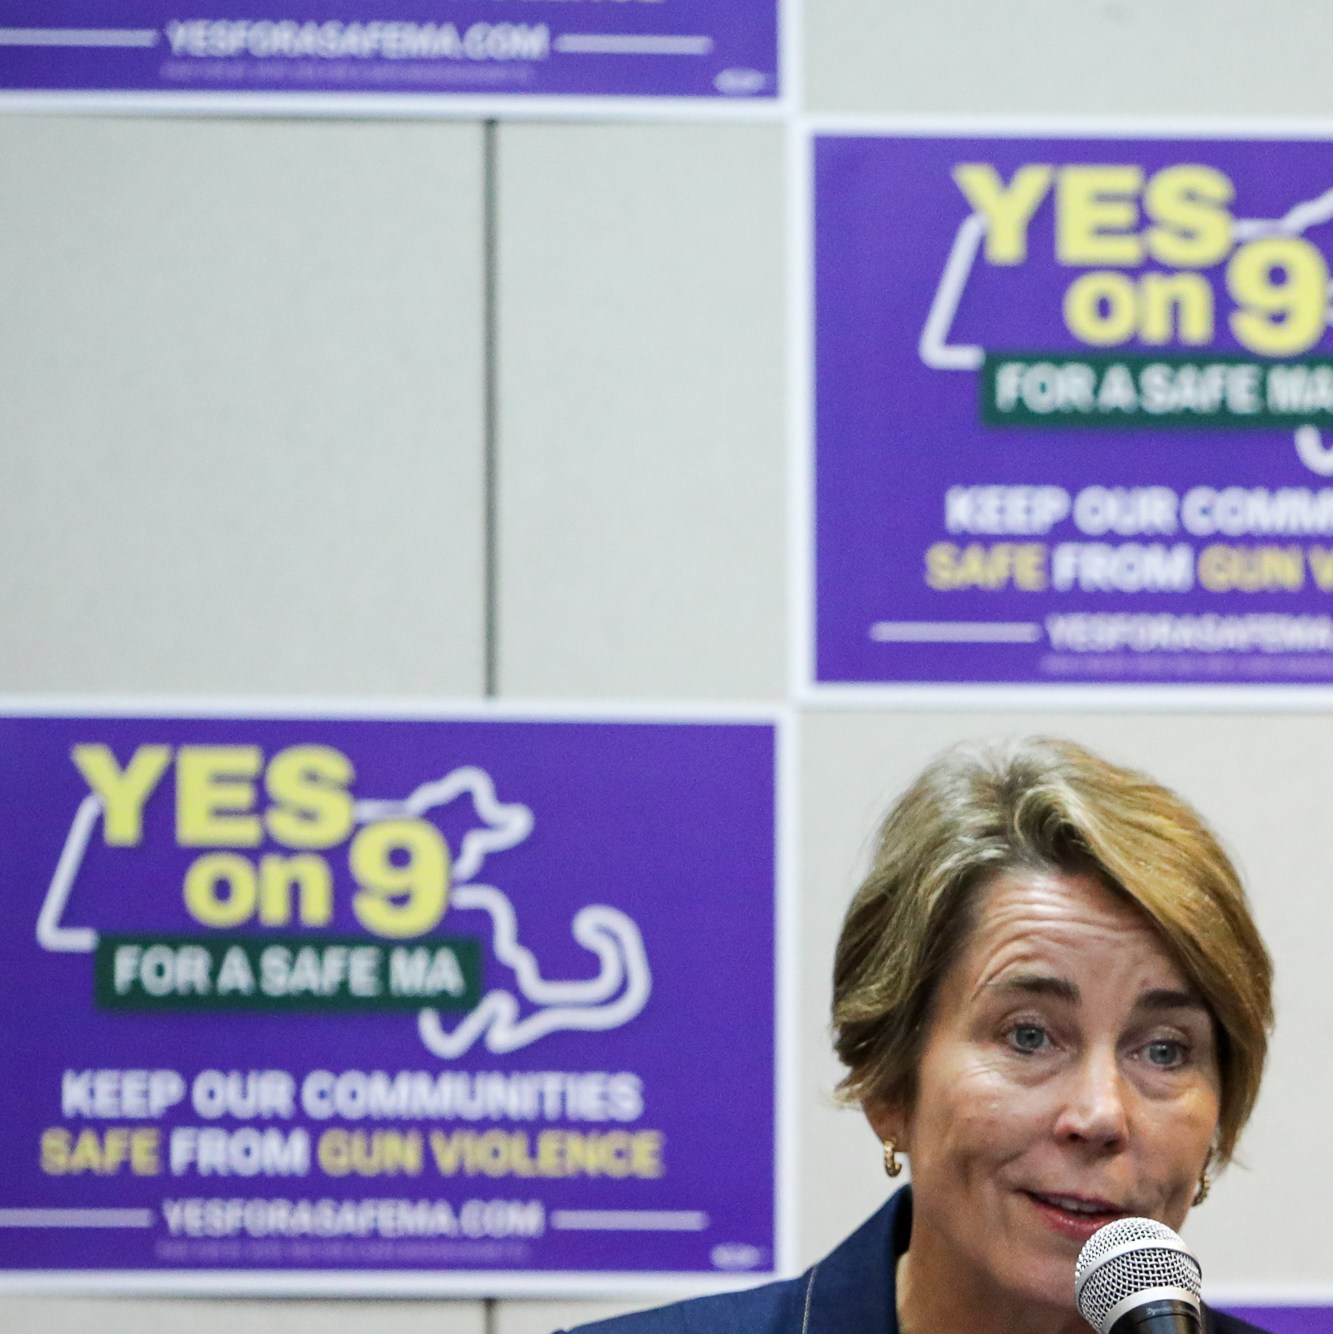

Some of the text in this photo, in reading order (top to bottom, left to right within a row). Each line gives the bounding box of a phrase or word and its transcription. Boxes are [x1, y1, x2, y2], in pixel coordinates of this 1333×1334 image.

[952, 163, 1234, 266] YES
[1063, 236, 1329, 356] on 9
[996, 363, 1096, 413] FOR
[1099, 364, 1137, 413] A
[1140, 364, 1262, 415] SAFE
[945, 486, 1070, 534] KEEP
[1074, 488, 1179, 536] OUR
[926, 543, 1047, 591] SAFE
[1051, 544, 1194, 592] FROM
[1200, 546, 1304, 592] GUN
[71, 742, 355, 847] YES
[183, 818, 452, 938] on 9
[113, 946, 464, 997] FOR A SAFE MA
[61, 1069, 643, 1122] KEEP OUR COMMUNITIES
[40, 1128, 664, 1179] SAFE FROM GUN VIOLENCE
